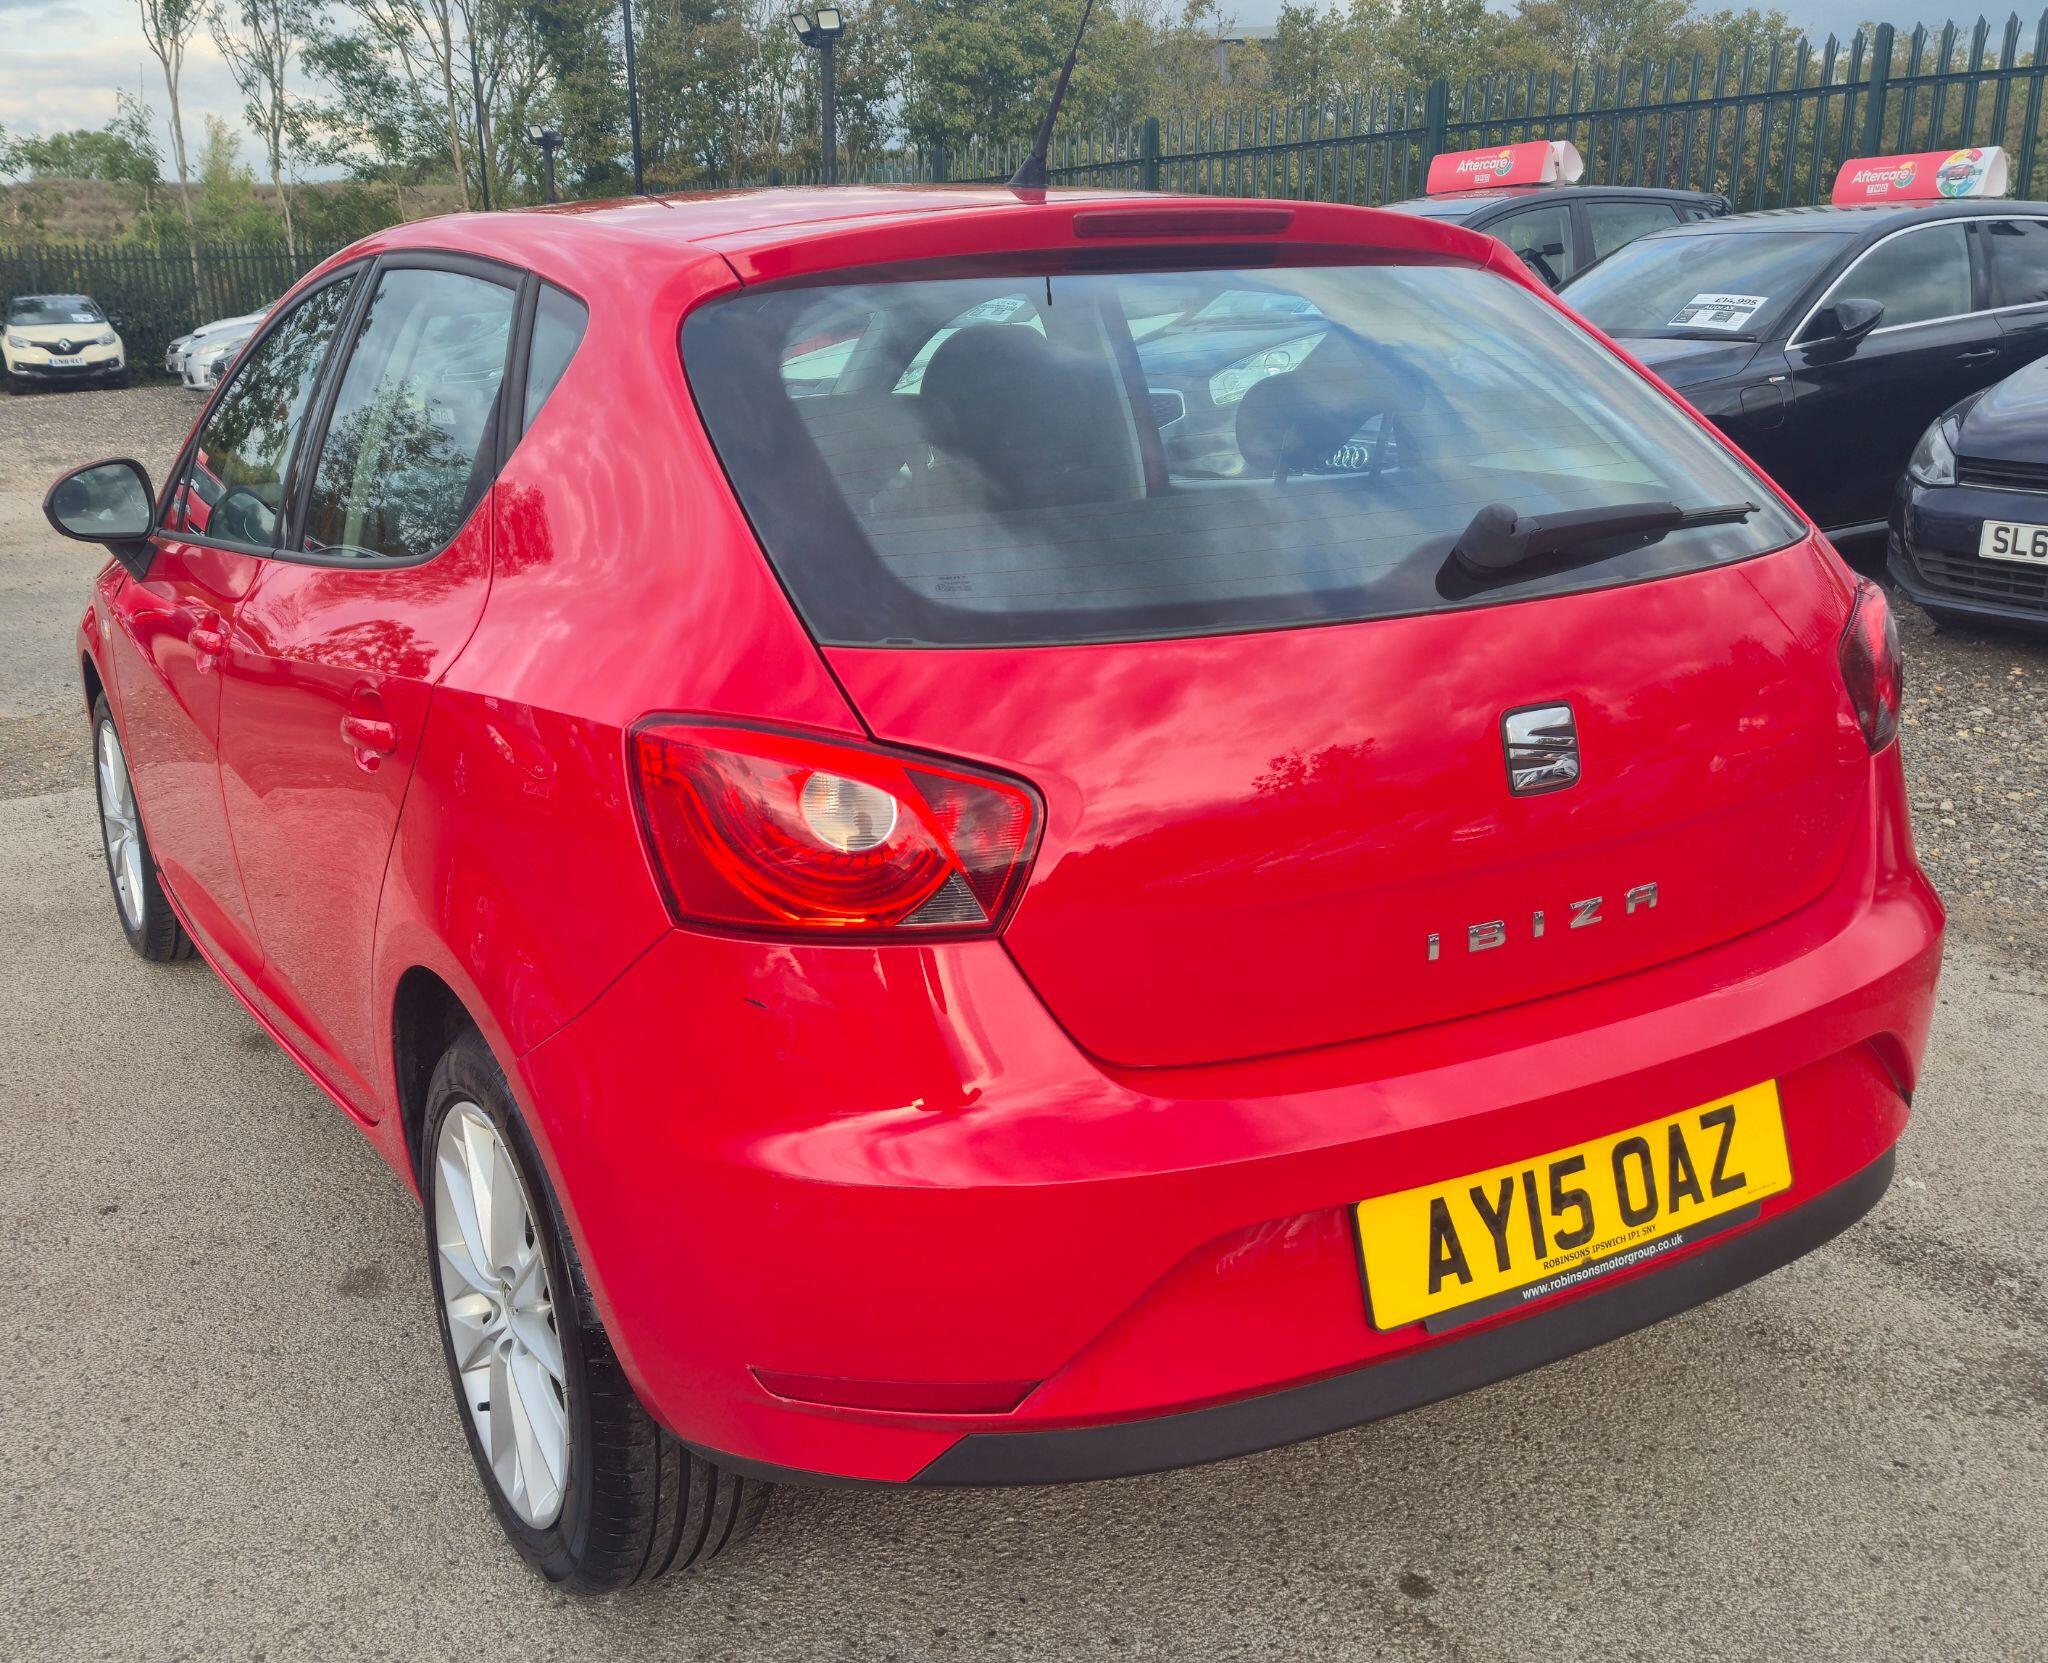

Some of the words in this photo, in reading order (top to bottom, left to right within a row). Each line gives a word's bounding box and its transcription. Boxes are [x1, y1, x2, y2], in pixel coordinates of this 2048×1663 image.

[1456, 159, 1508, 173] Aftercare
[1852, 169, 1909, 184] Aftercare
[1427, 882, 1659, 961] IBIZA
[1427, 1154, 1595, 1296] AY15
[1611, 1104, 1747, 1228] OAZ
[1522, 1233, 1684, 1300] www.robinsonsmotorgroup.co.uk
[1543, 1247, 1591, 1270] ROBINSONS
[1592, 1234, 1627, 1254] IPSWICH
[1628, 1229, 1641, 1241] IP1
[1642, 1224, 1657, 1236] 5NY
